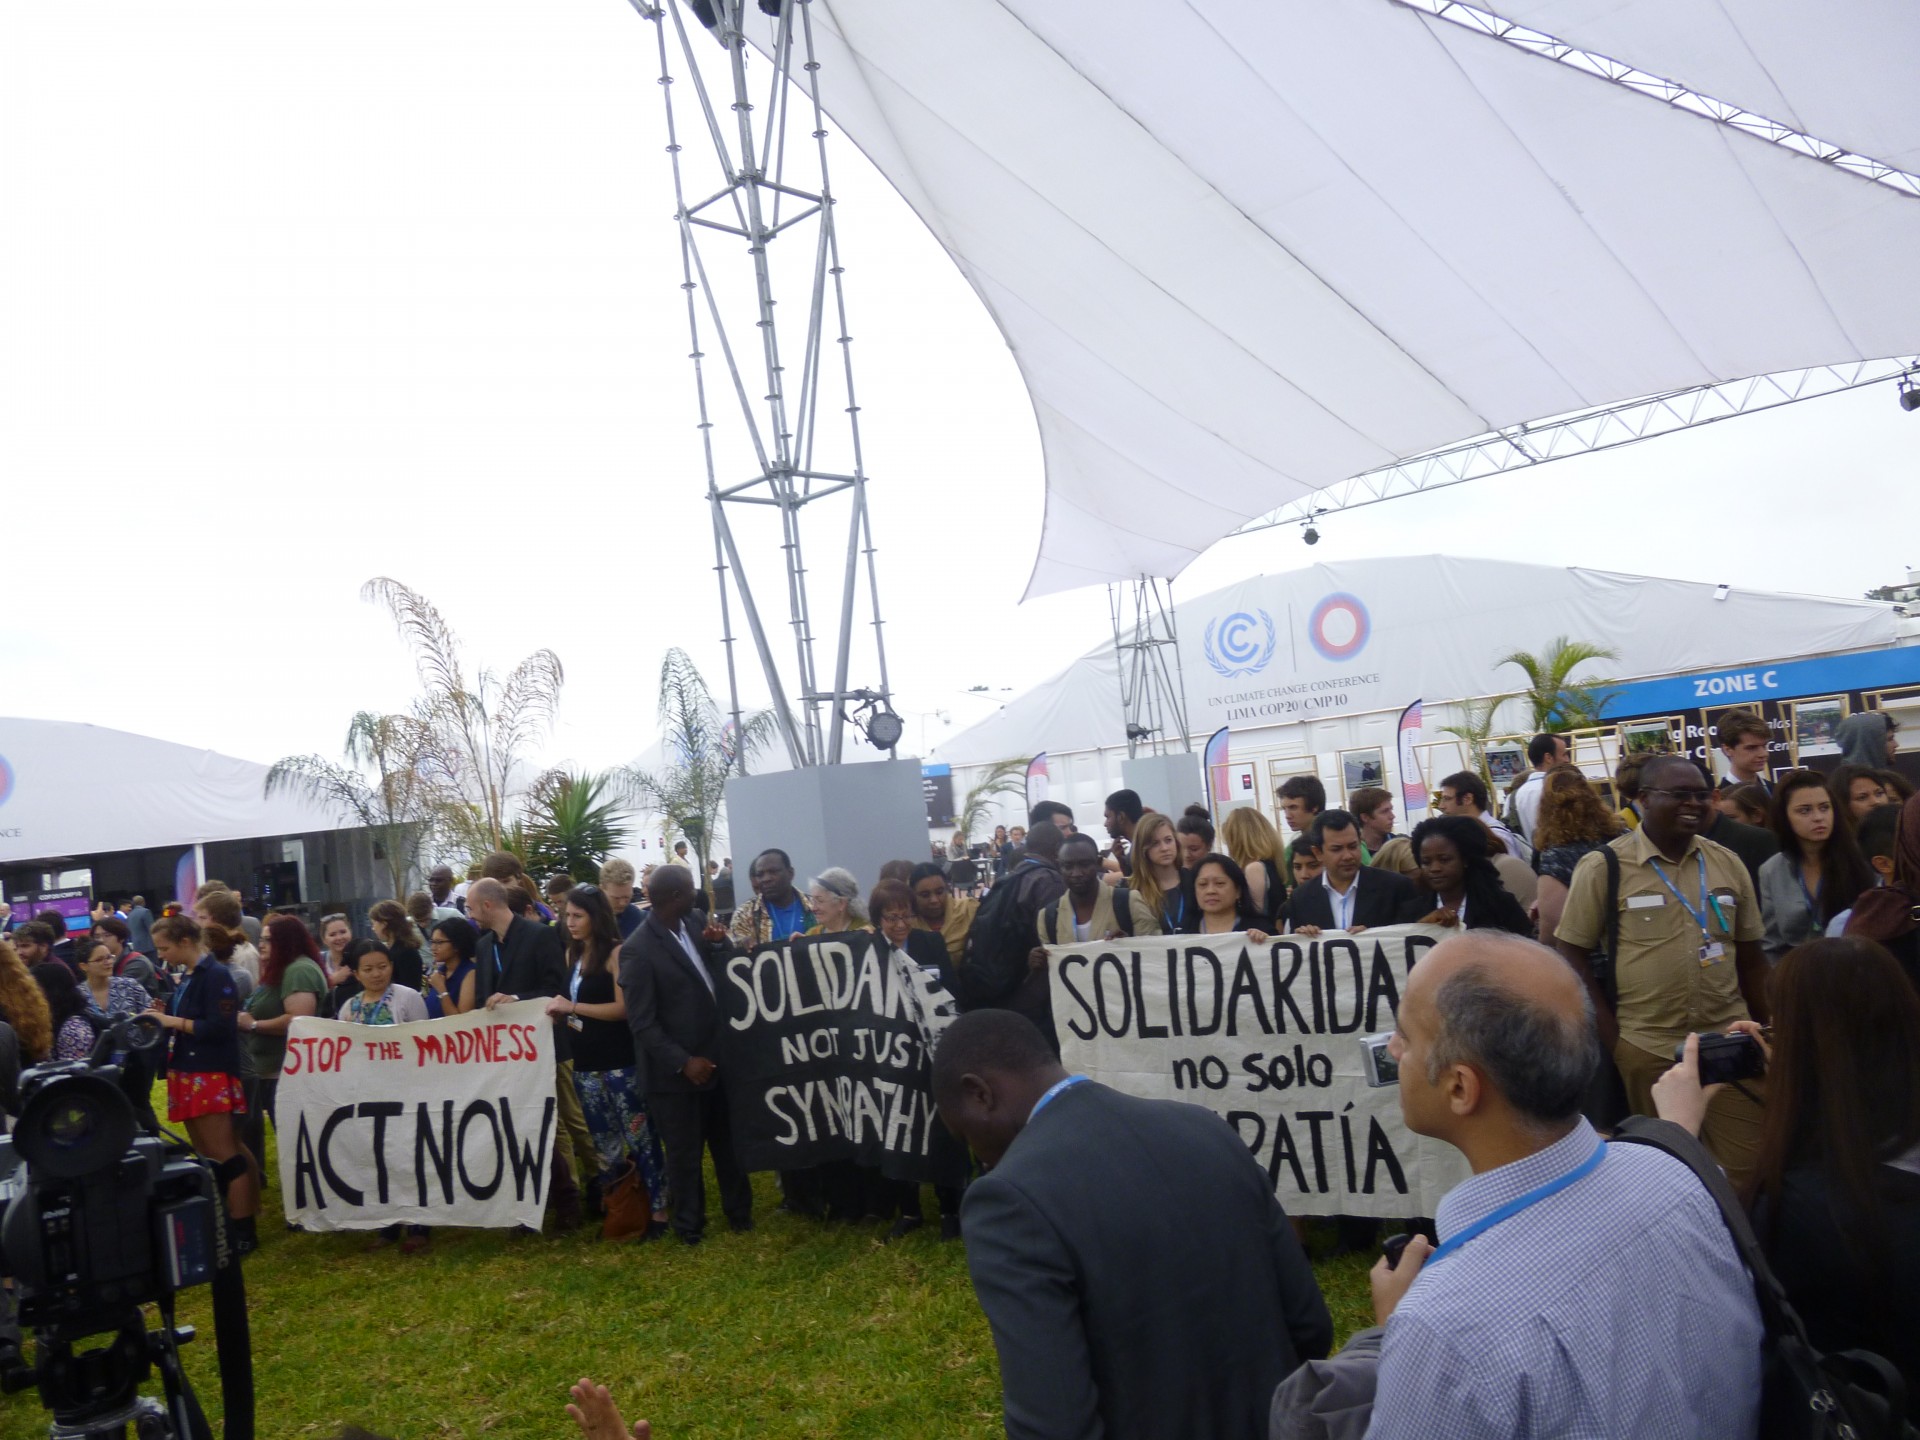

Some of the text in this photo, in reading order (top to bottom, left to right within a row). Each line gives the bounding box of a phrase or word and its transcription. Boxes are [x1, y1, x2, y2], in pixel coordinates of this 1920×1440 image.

[1208, 673, 1381, 707] UN CLIMATE CHANGE CONFERENCE
[1694, 671, 1778, 697] ZONE C
[1227, 705, 1257, 721] LIMA
[284, 1024, 538, 1075] STOP THE MADNESS
[781, 1027, 926, 1071] NOT JUST
[1172, 1044, 1333, 1092] no solo
[296, 1096, 556, 1210] ACT NOW
[1214, 1101, 1409, 1194] PATÍA
